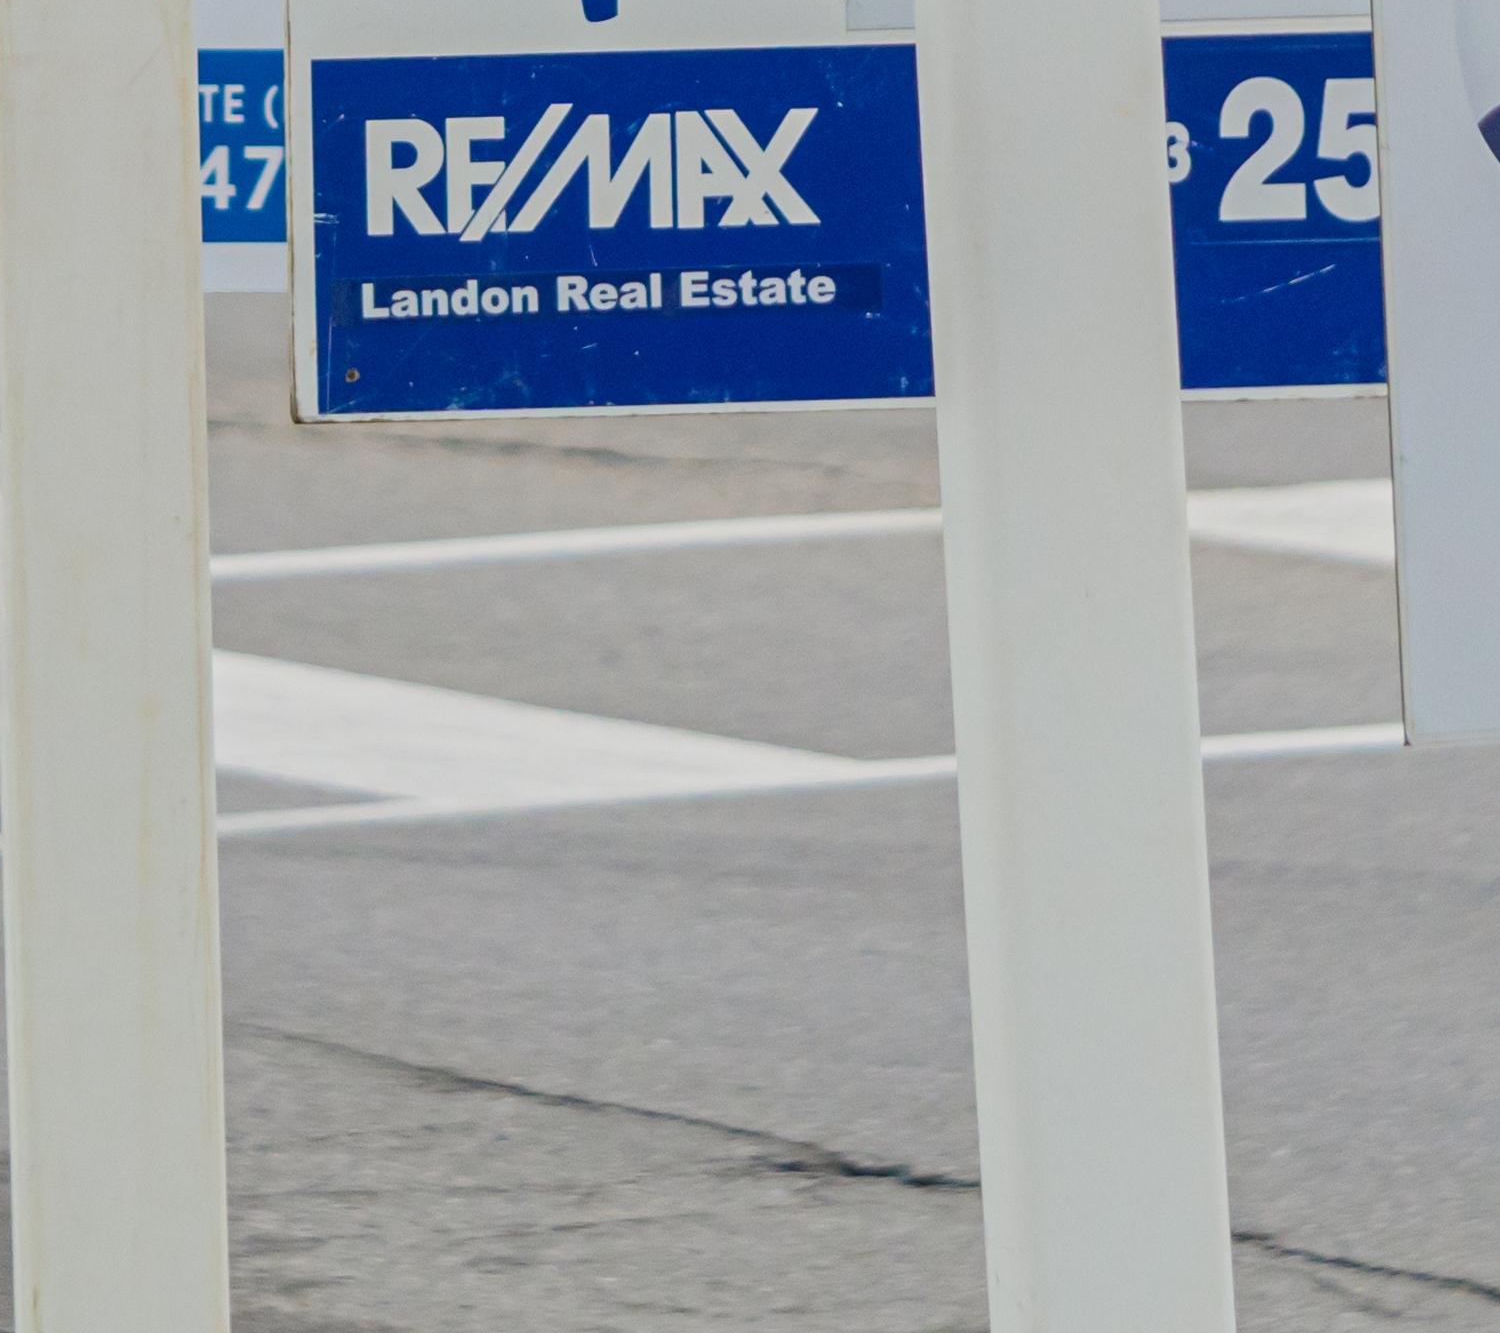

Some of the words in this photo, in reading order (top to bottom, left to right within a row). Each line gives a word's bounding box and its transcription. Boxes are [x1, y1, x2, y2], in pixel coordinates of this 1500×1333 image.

[364, 102, 822, 243] RE/MAX
[360, 279, 540, 320] Landon
[556, 274, 662, 310] Real
[680, 269, 836, 308] Estate
